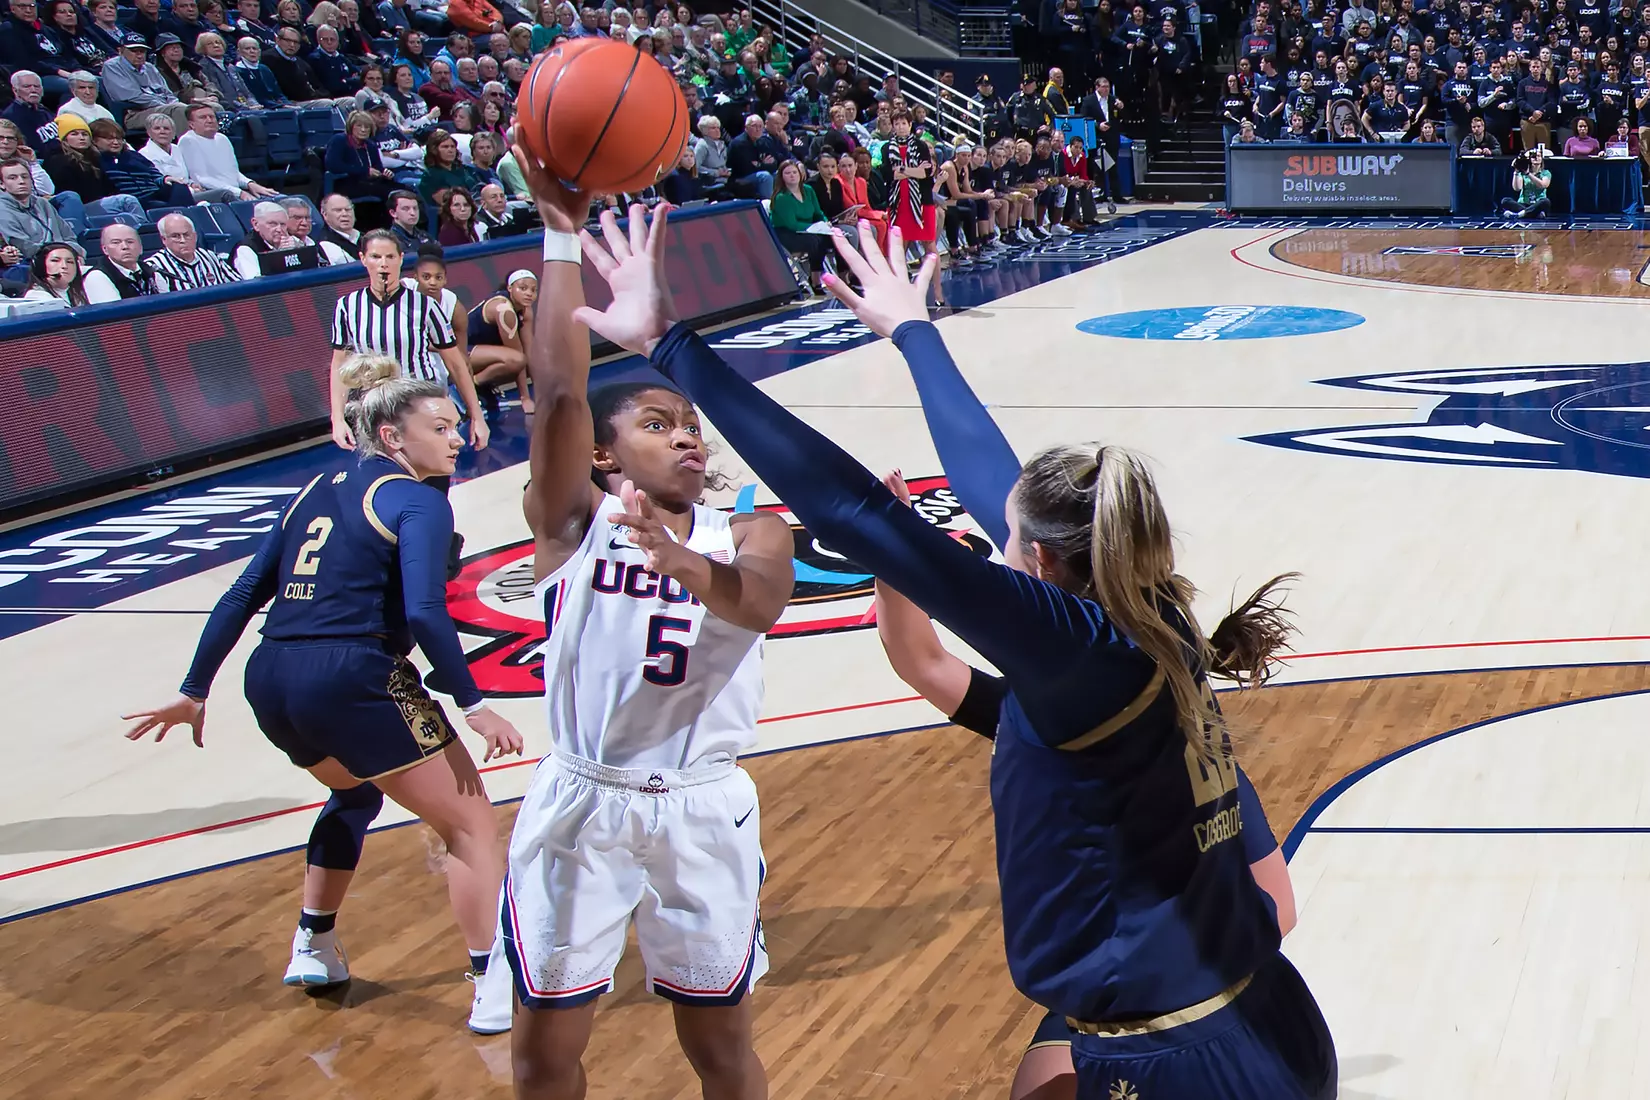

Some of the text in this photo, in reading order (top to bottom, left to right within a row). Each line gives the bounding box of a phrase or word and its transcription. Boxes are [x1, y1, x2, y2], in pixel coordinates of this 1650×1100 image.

[1601, 88, 1623, 97] UCONN
[1283, 153, 1404, 177] SUBWAY
[1283, 178, 1347, 192] Delivers
[1283, 194, 1312, 203] Delivery
[292, 516, 334, 575] 2
[284, 582, 316, 600] COLE
[642, 614, 692, 687] 5
[639, 785, 670, 793] UCONN
